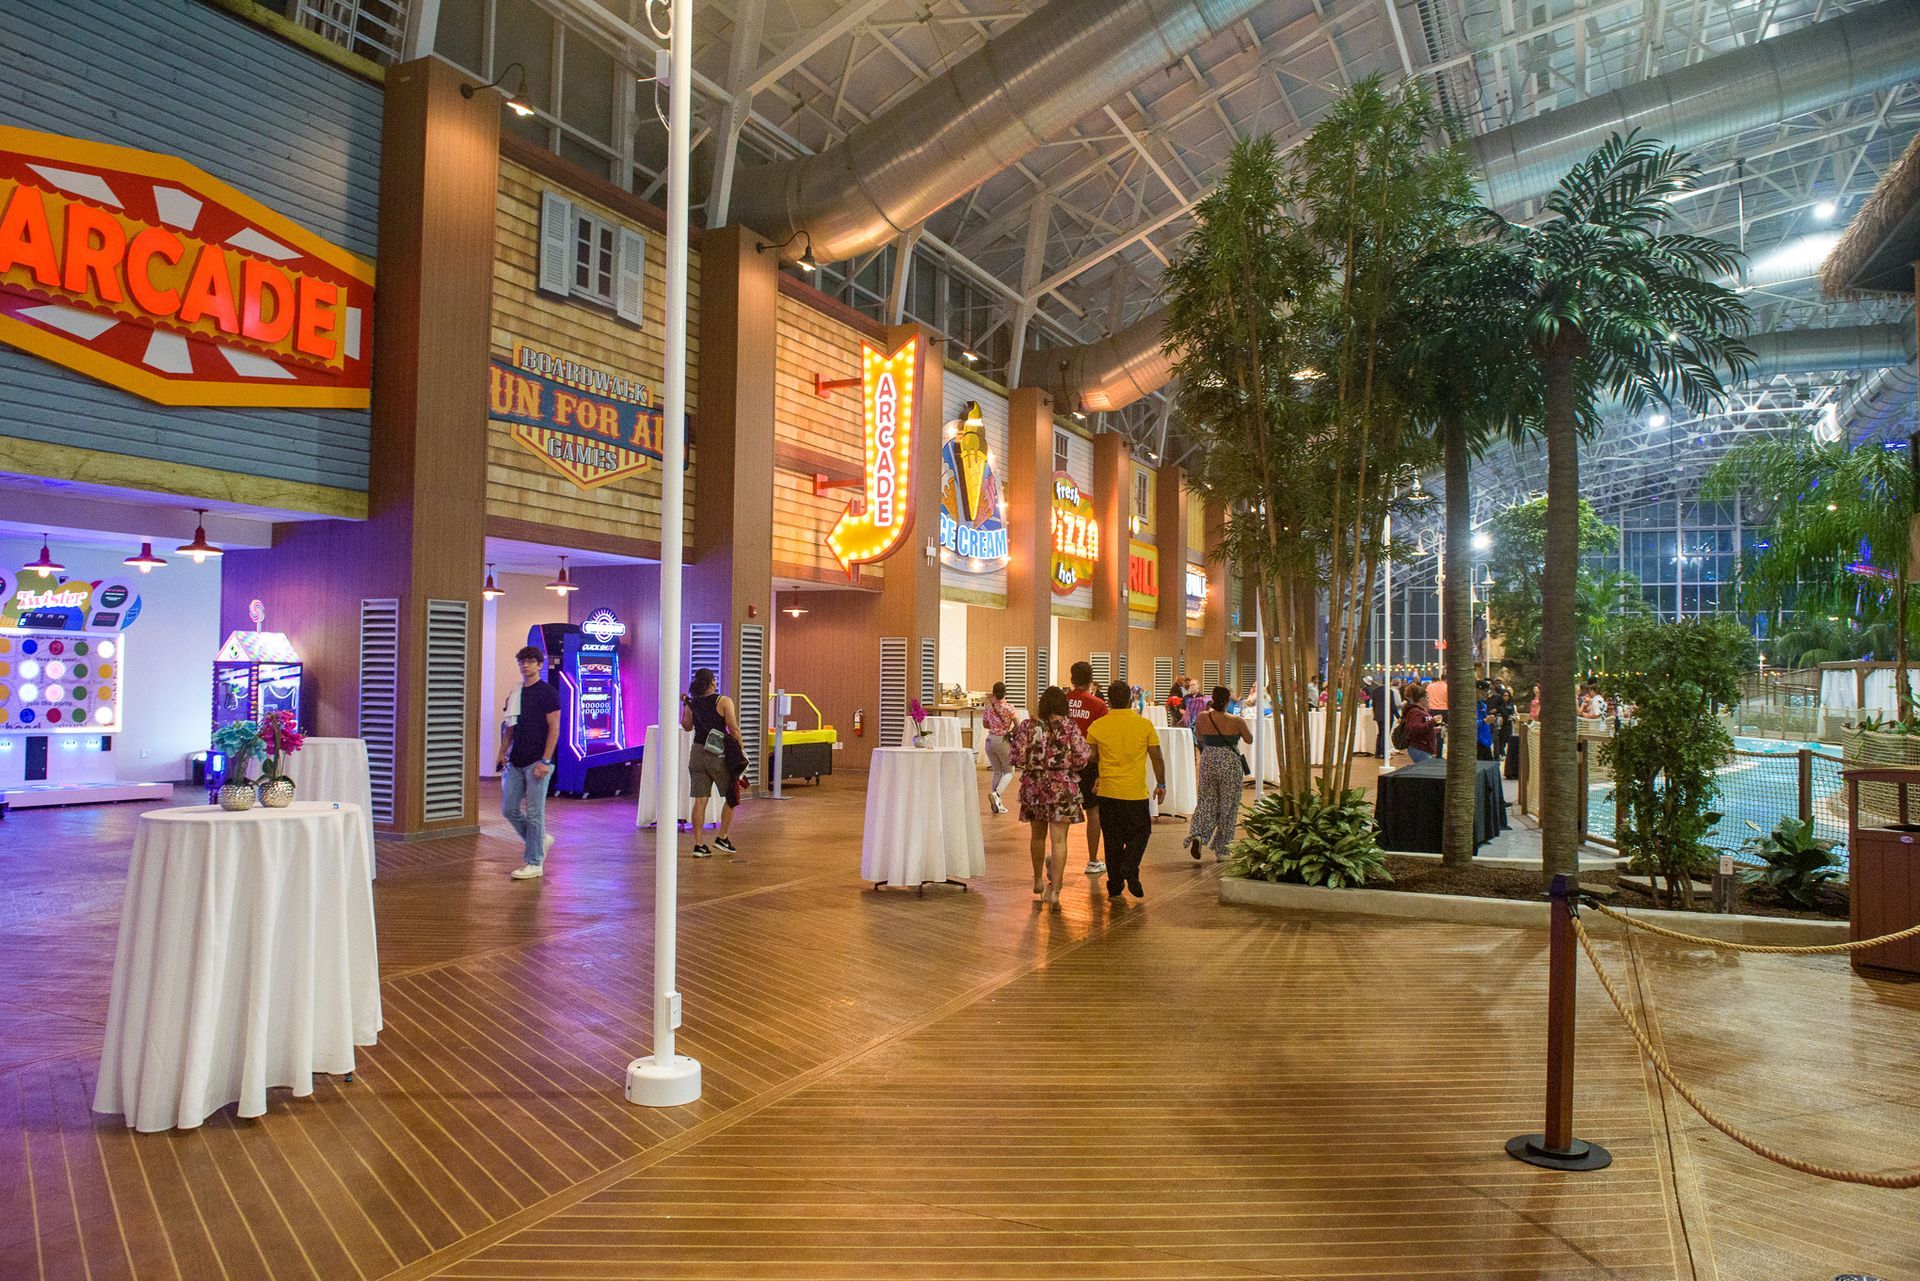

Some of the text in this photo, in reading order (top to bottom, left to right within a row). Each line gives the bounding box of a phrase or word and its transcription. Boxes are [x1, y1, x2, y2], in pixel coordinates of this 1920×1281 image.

[0, 184, 338, 360] ARCADE
[520, 345, 648, 403] BOARDWALK
[488, 364, 545, 420] UN
[553, 389, 620, 440] FOR
[547, 436, 618, 472] GAMES
[875, 373, 897, 526] ARCADE
[1055, 480, 1080, 507] fresh
[940, 512, 1008, 560] CE CREAM
[1058, 561, 1078, 584] hot
[1128, 554, 1159, 597] RILL
[1069, 699, 1082, 708] EAD
